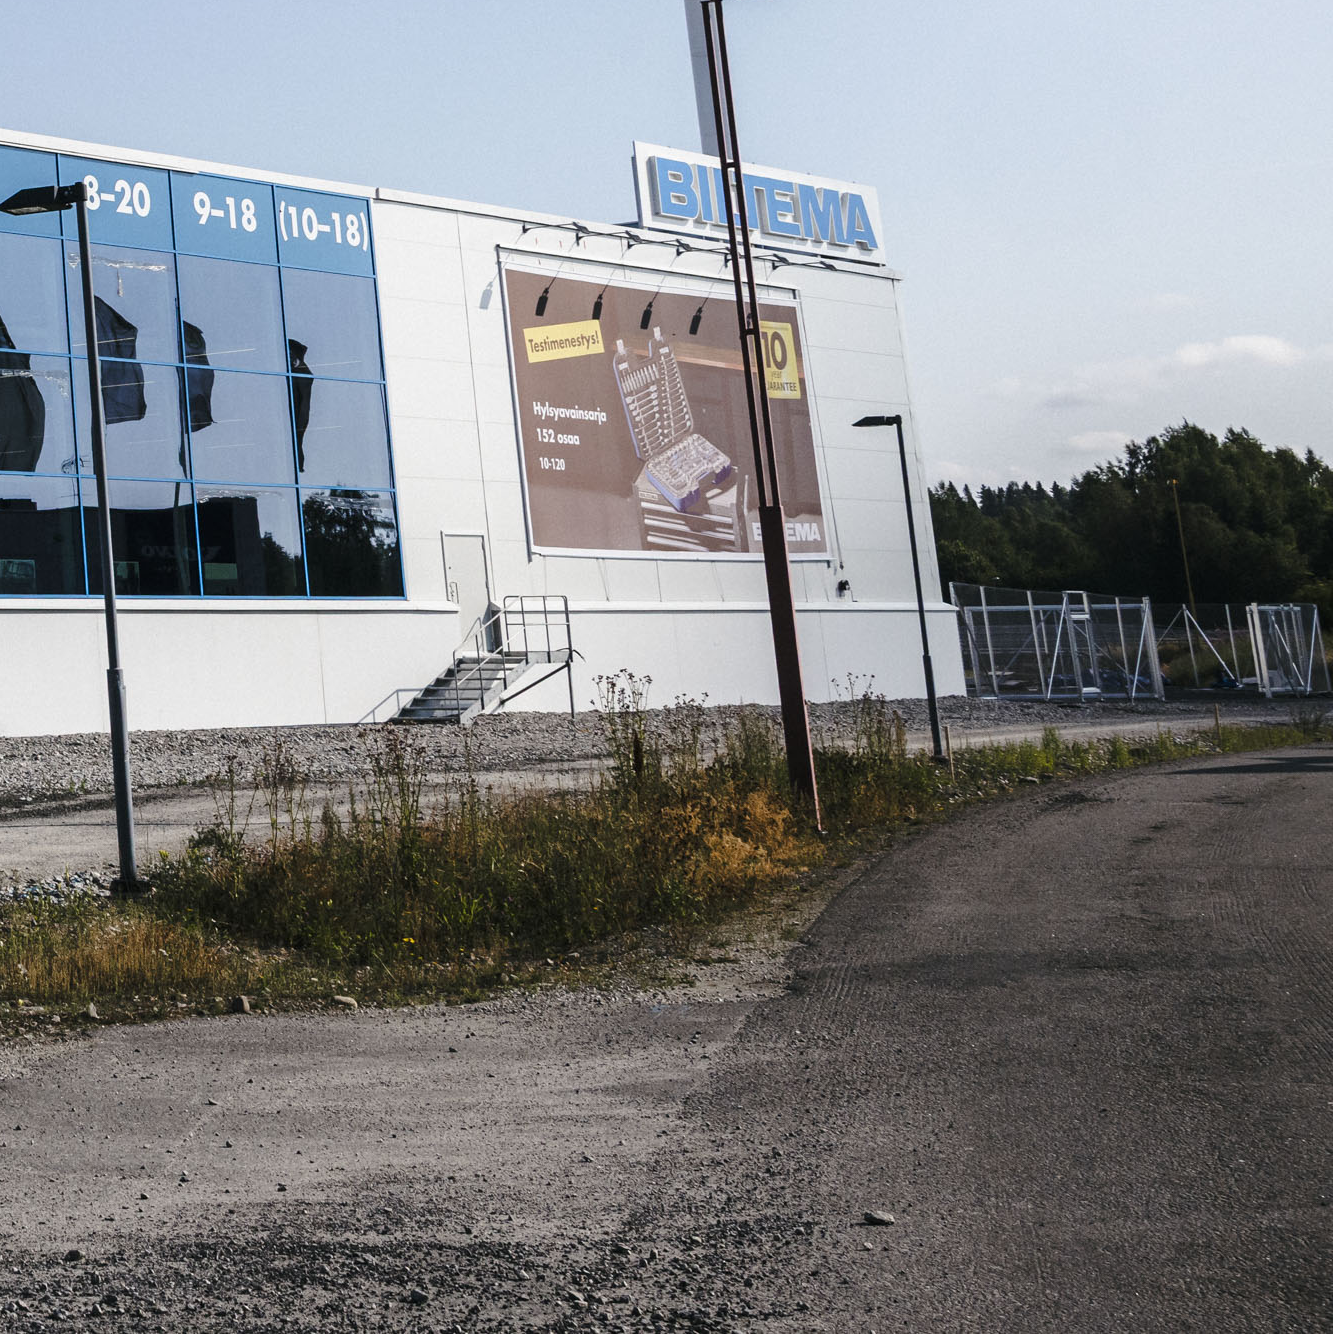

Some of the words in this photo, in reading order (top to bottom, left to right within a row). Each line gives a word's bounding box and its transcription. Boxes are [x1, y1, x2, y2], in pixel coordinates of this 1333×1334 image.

[82, 174, 151, 218] 8-20
[192, 191, 258, 233] 9-18
[278, 199, 368, 252] (10-18)
[528, 330, 600, 353] Testimenestys!
[761, 331, 788, 370] 10
[532, 401, 607, 425] Hylsyavainsarja
[536, 428, 556, 443] 152
[557, 432, 581, 445] osaa
[539, 456, 566, 471] 10-120
